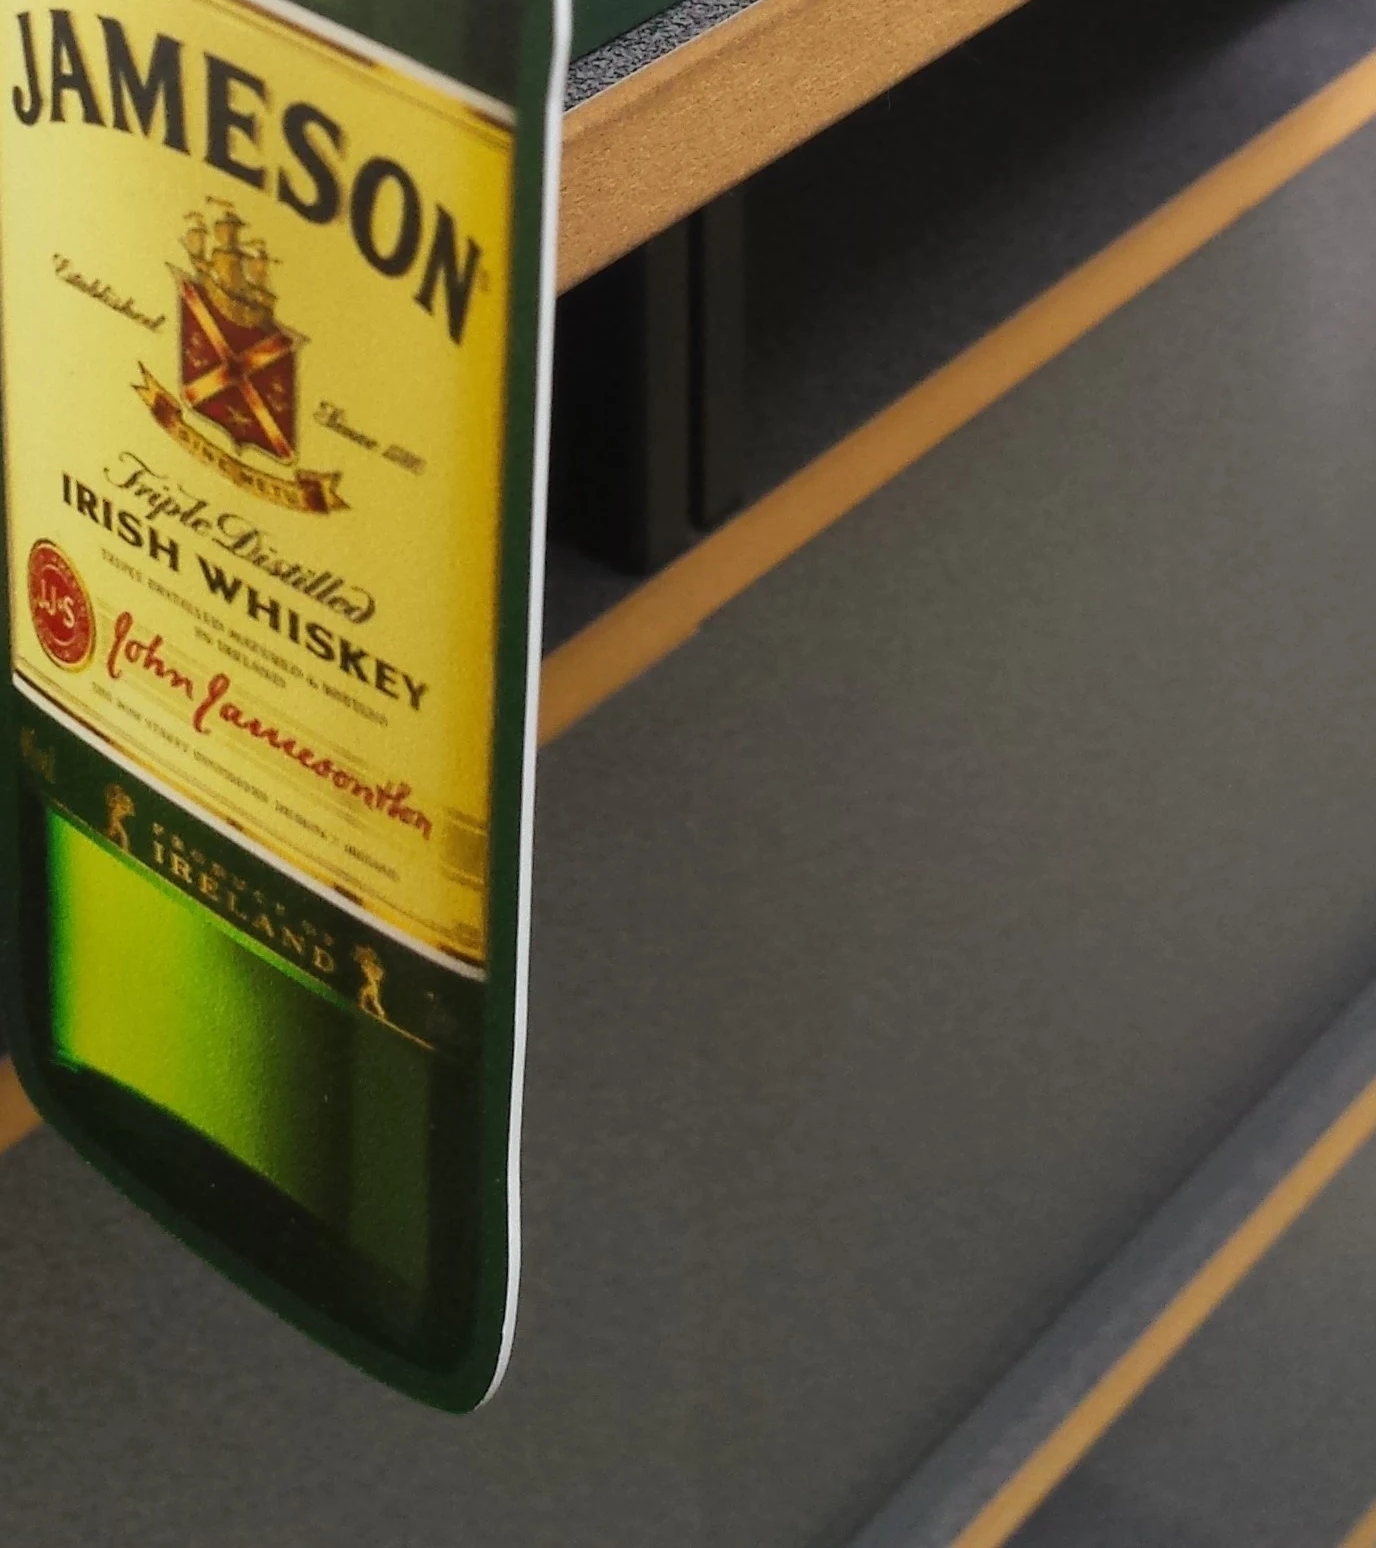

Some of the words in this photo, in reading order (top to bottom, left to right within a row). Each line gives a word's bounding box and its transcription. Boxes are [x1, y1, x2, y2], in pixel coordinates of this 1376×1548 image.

[12, 7, 482, 347] JAMESON
[61, 471, 183, 574] IRISH
[194, 551, 431, 712] WHISKEY
[103, 451, 213, 533] Triple
[211, 511, 377, 625] Distilled
[107, 610, 194, 700] John
[153, 839, 336, 975] IRELAND
